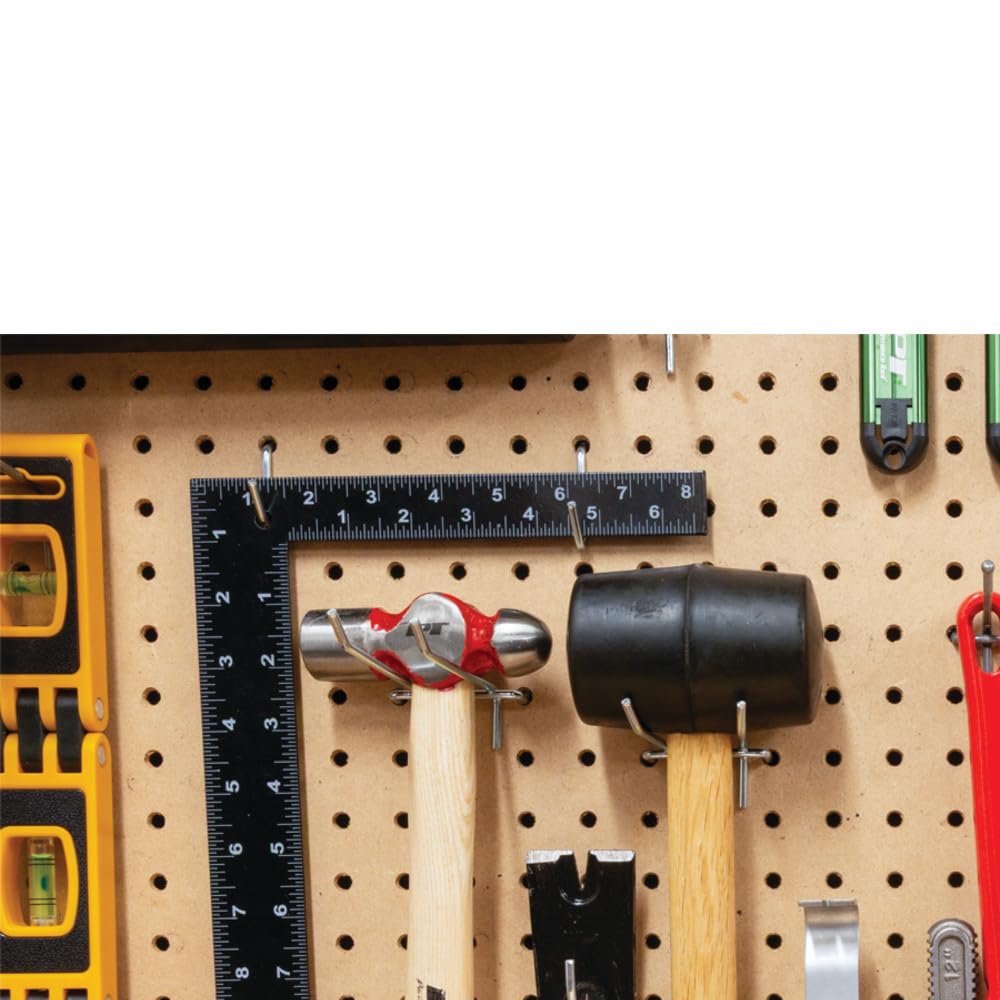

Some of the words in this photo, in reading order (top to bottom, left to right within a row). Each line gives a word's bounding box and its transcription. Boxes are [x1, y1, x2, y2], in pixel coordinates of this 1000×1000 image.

[242, 492, 251, 506] 1
[303, 490, 314, 505] 2
[366, 489, 377, 504] 3
[428, 488, 440, 503] 4
[492, 487, 503, 502] 5
[554, 486, 566, 501] 6
[616, 485, 628, 500] 7
[680, 484, 692, 499] 8
[337, 509, 346, 524] 1
[398, 508, 409, 523] 2
[461, 508, 472, 522] 3
[522, 506, 535, 521] 4
[586, 505, 598, 520] 5
[648, 504, 660, 519] 6
[212, 530, 227, 539] 1
[215, 591, 230, 604] 2
[257, 593, 272, 602] 1
[218, 655, 233, 667] 3
[260, 654, 275, 666] 2
[222, 717, 236, 731] 4
[264, 717, 278, 730] 3
[225, 780, 240, 793] 5
[267, 780, 281, 793] 4
[228, 843, 243, 855] 6
[270, 842, 284, 854] 5
[232, 905, 246, 917] 7
[273, 904, 288, 917] 6
[235, 966, 250, 979] 8
[276, 966, 291, 978] 7
